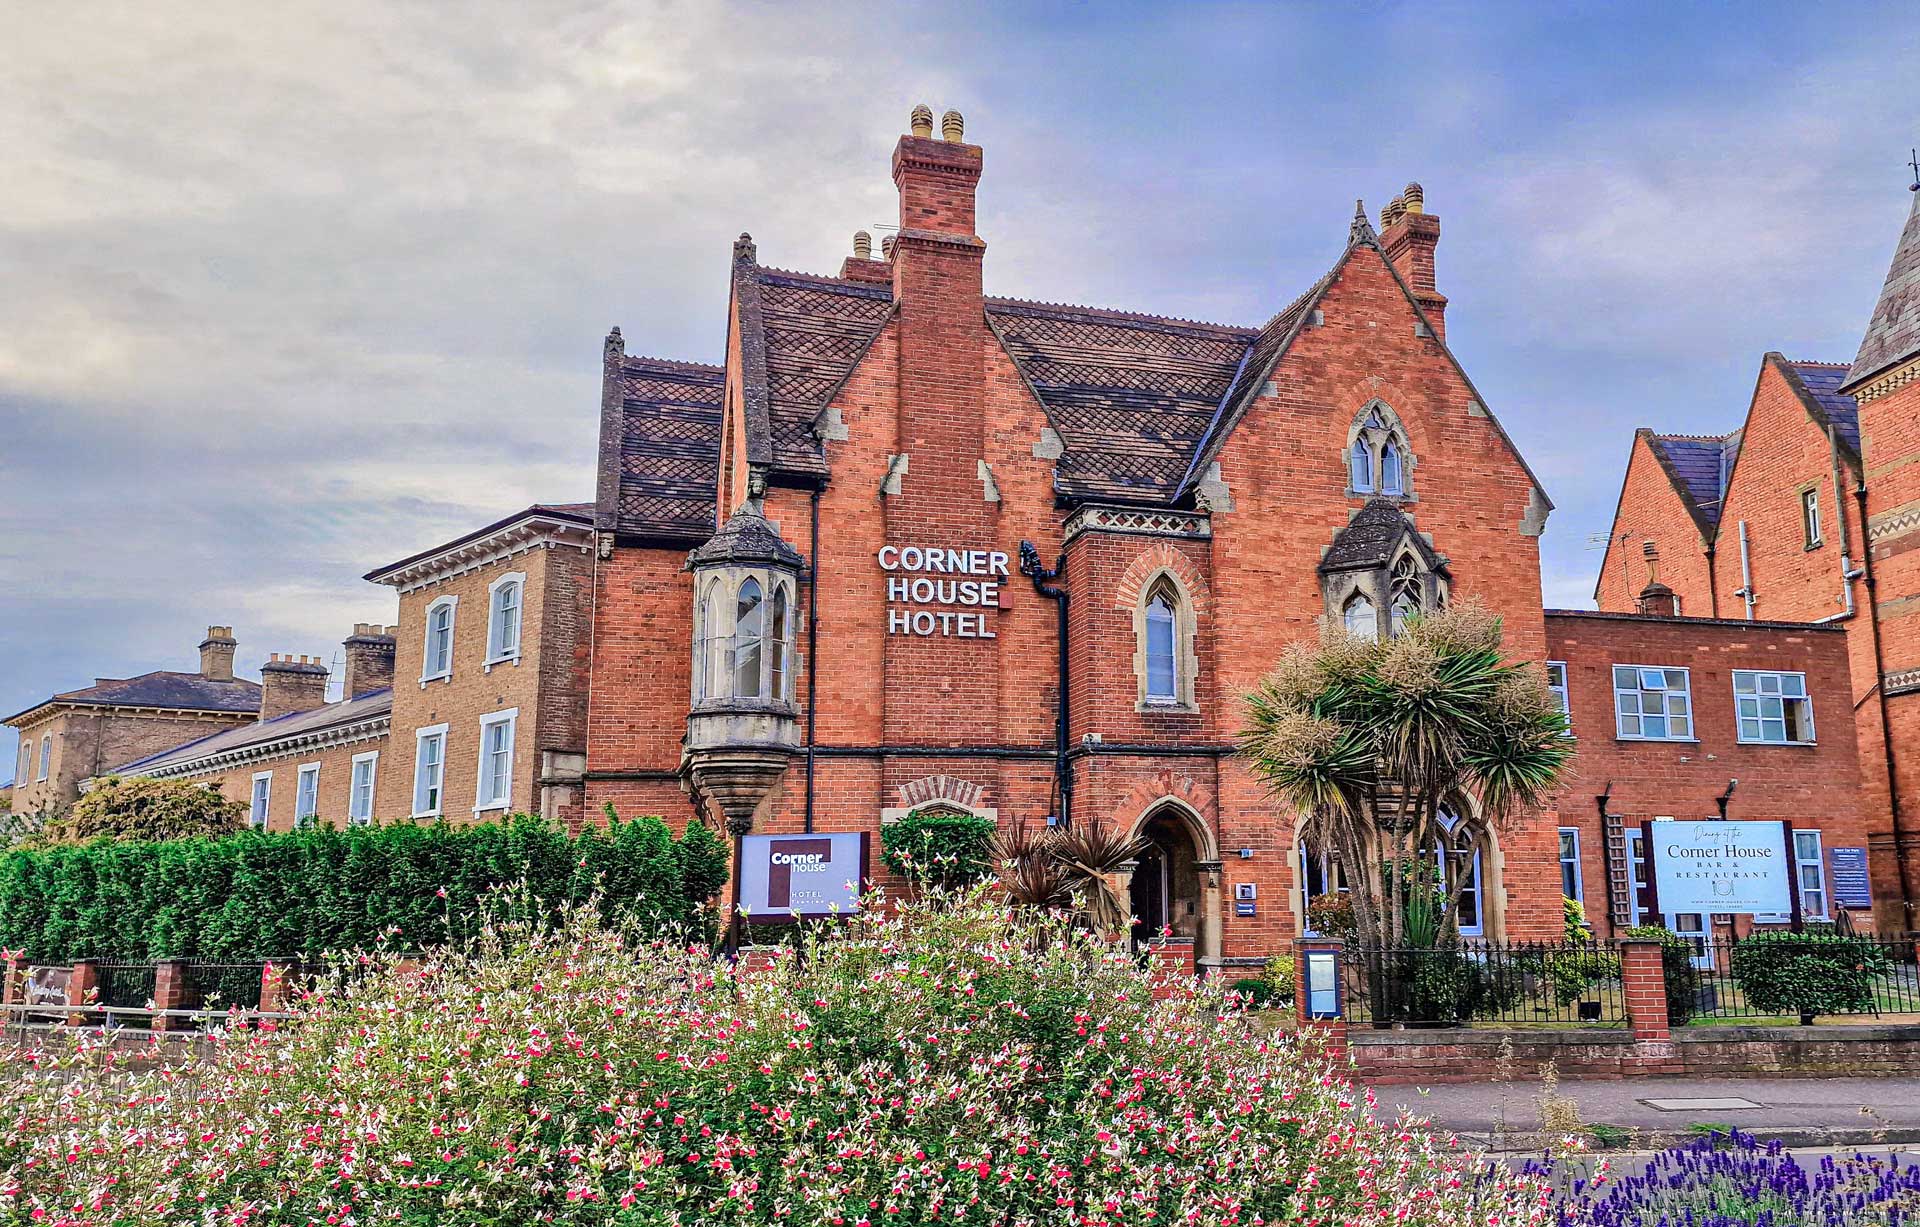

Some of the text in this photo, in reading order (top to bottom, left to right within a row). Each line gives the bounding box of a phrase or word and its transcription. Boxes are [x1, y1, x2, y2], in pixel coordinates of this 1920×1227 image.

[878, 545, 1010, 576] CORNER
[888, 577, 999, 606] HOUSE
[889, 609, 996, 638] HOTEL
[1667, 844, 1772, 858] Corner House
[771, 852, 823, 865] Corner
[792, 862, 826, 873] house
[1676, 871, 1769, 879] RESTAURANT
